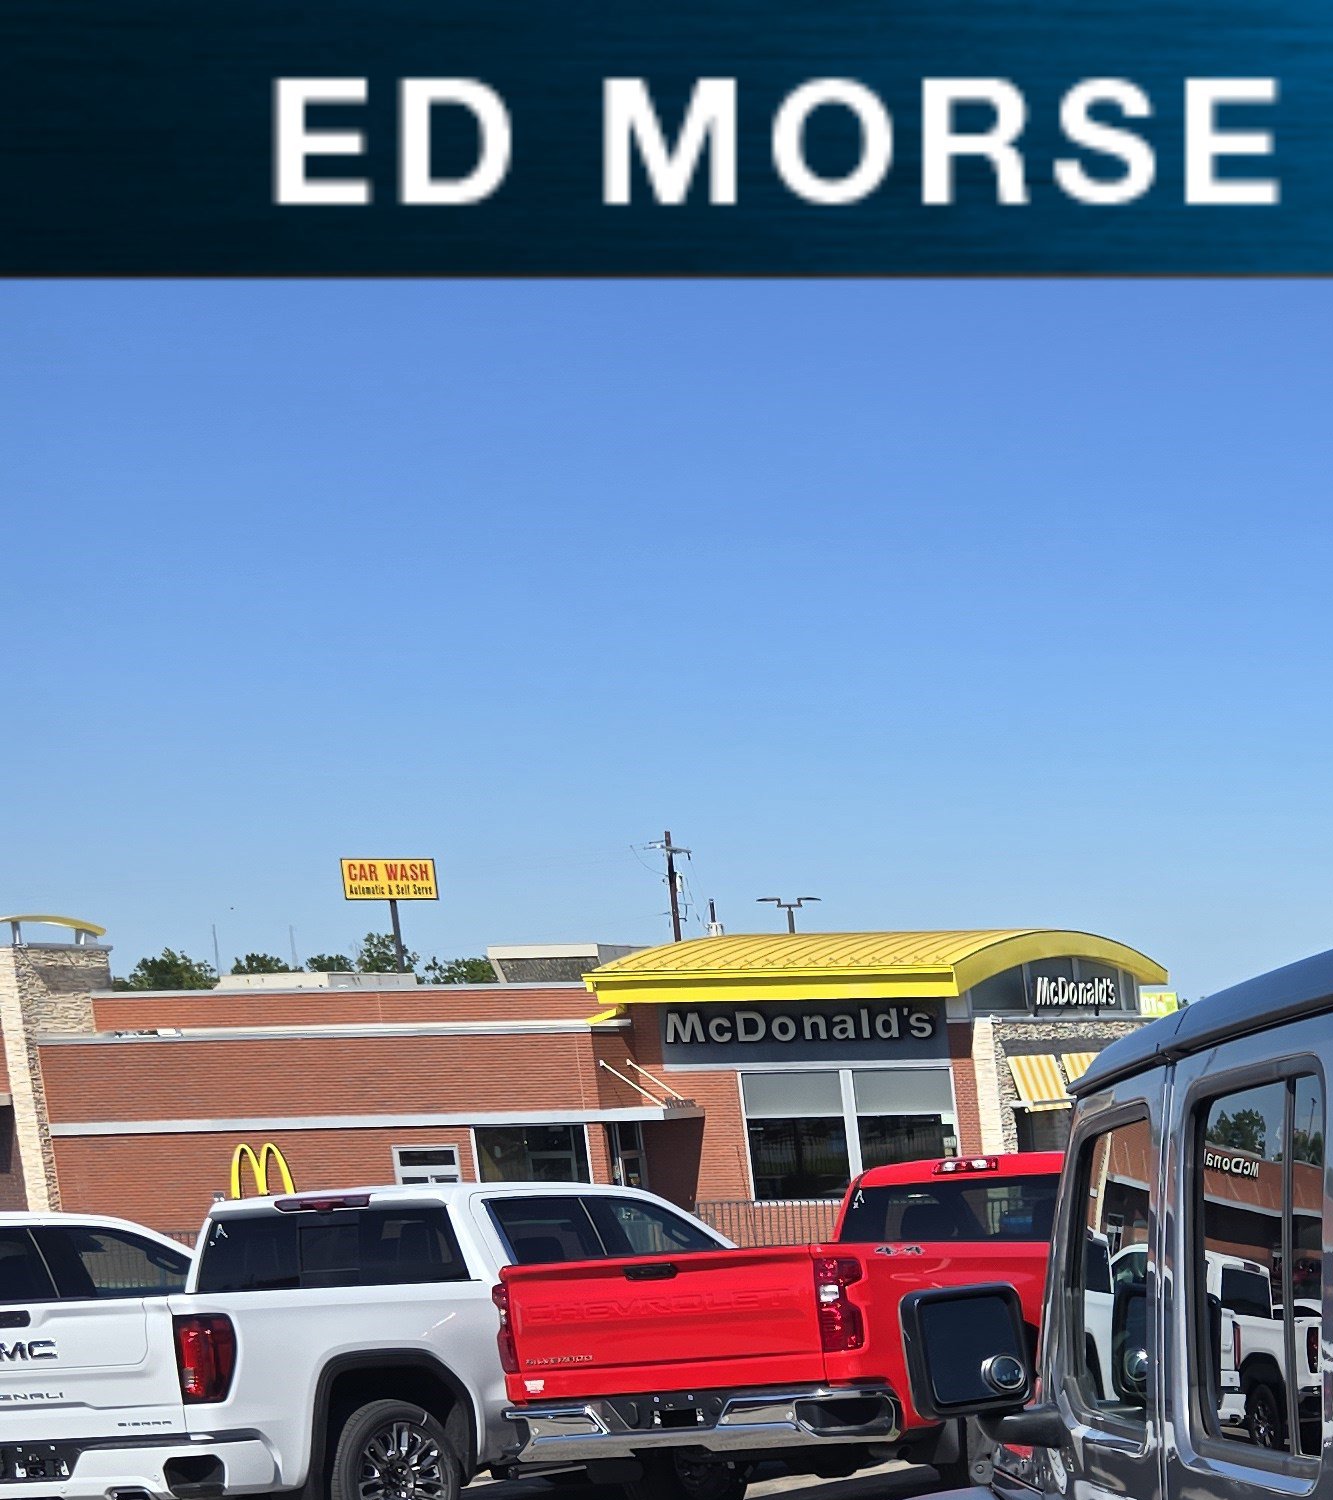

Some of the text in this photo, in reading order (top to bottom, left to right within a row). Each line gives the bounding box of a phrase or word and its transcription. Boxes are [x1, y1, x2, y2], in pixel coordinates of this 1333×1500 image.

[348, 863, 430, 881] CAR WASH
[349, 884, 385, 895] Automatic
[396, 884, 411, 895] Self
[413, 884, 433, 895] Serve
[1036, 976, 1116, 1007] McDonald's
[665, 1007, 934, 1045] McDonald's
